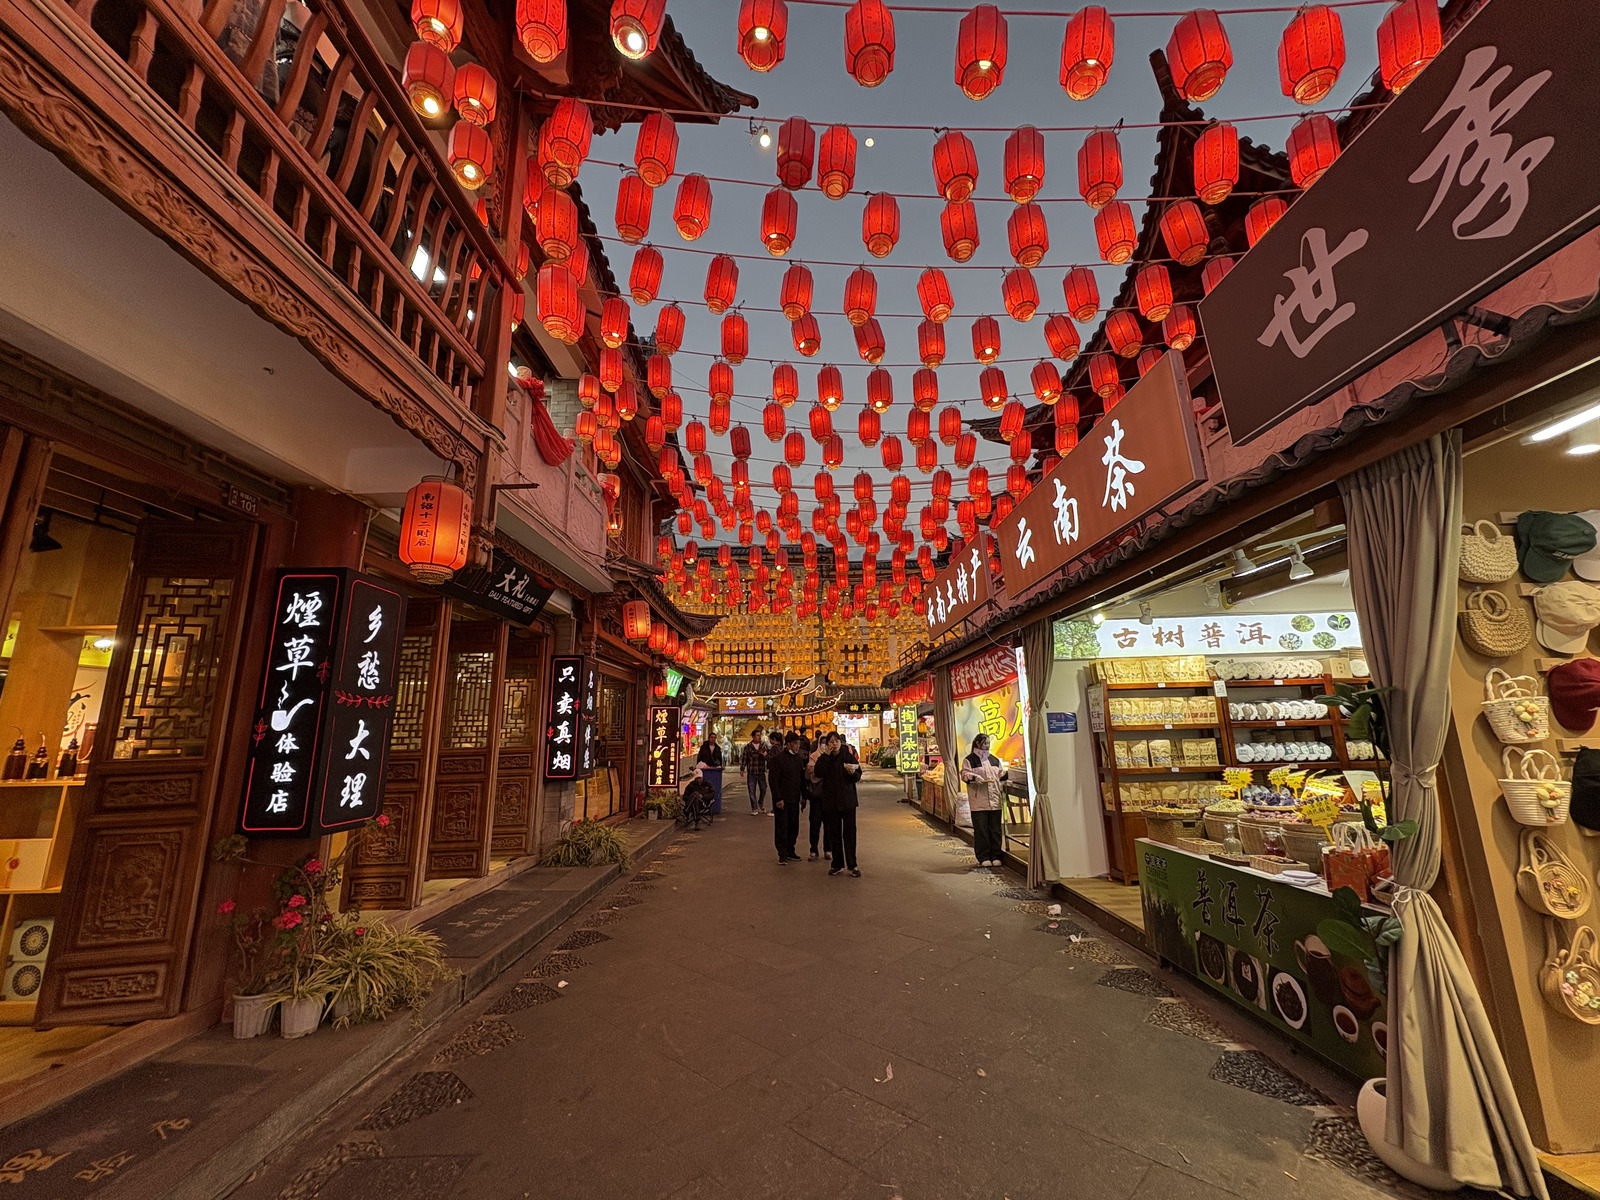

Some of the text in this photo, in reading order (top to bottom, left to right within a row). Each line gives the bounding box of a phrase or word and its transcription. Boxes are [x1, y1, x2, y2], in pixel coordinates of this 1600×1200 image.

[241, 499, 256, 513] 101
[1015, 418, 1146, 569] 云南茶
[495, 567, 530, 599] 大礼
[927, 547, 982, 628] 云南土特产
[1112, 621, 1272, 650] 古树普洱
[552, 665, 576, 771] 只卖真烟
[901, 709, 918, 752] 掏耳朵
[1192, 867, 1280, 957] 普洱茶
